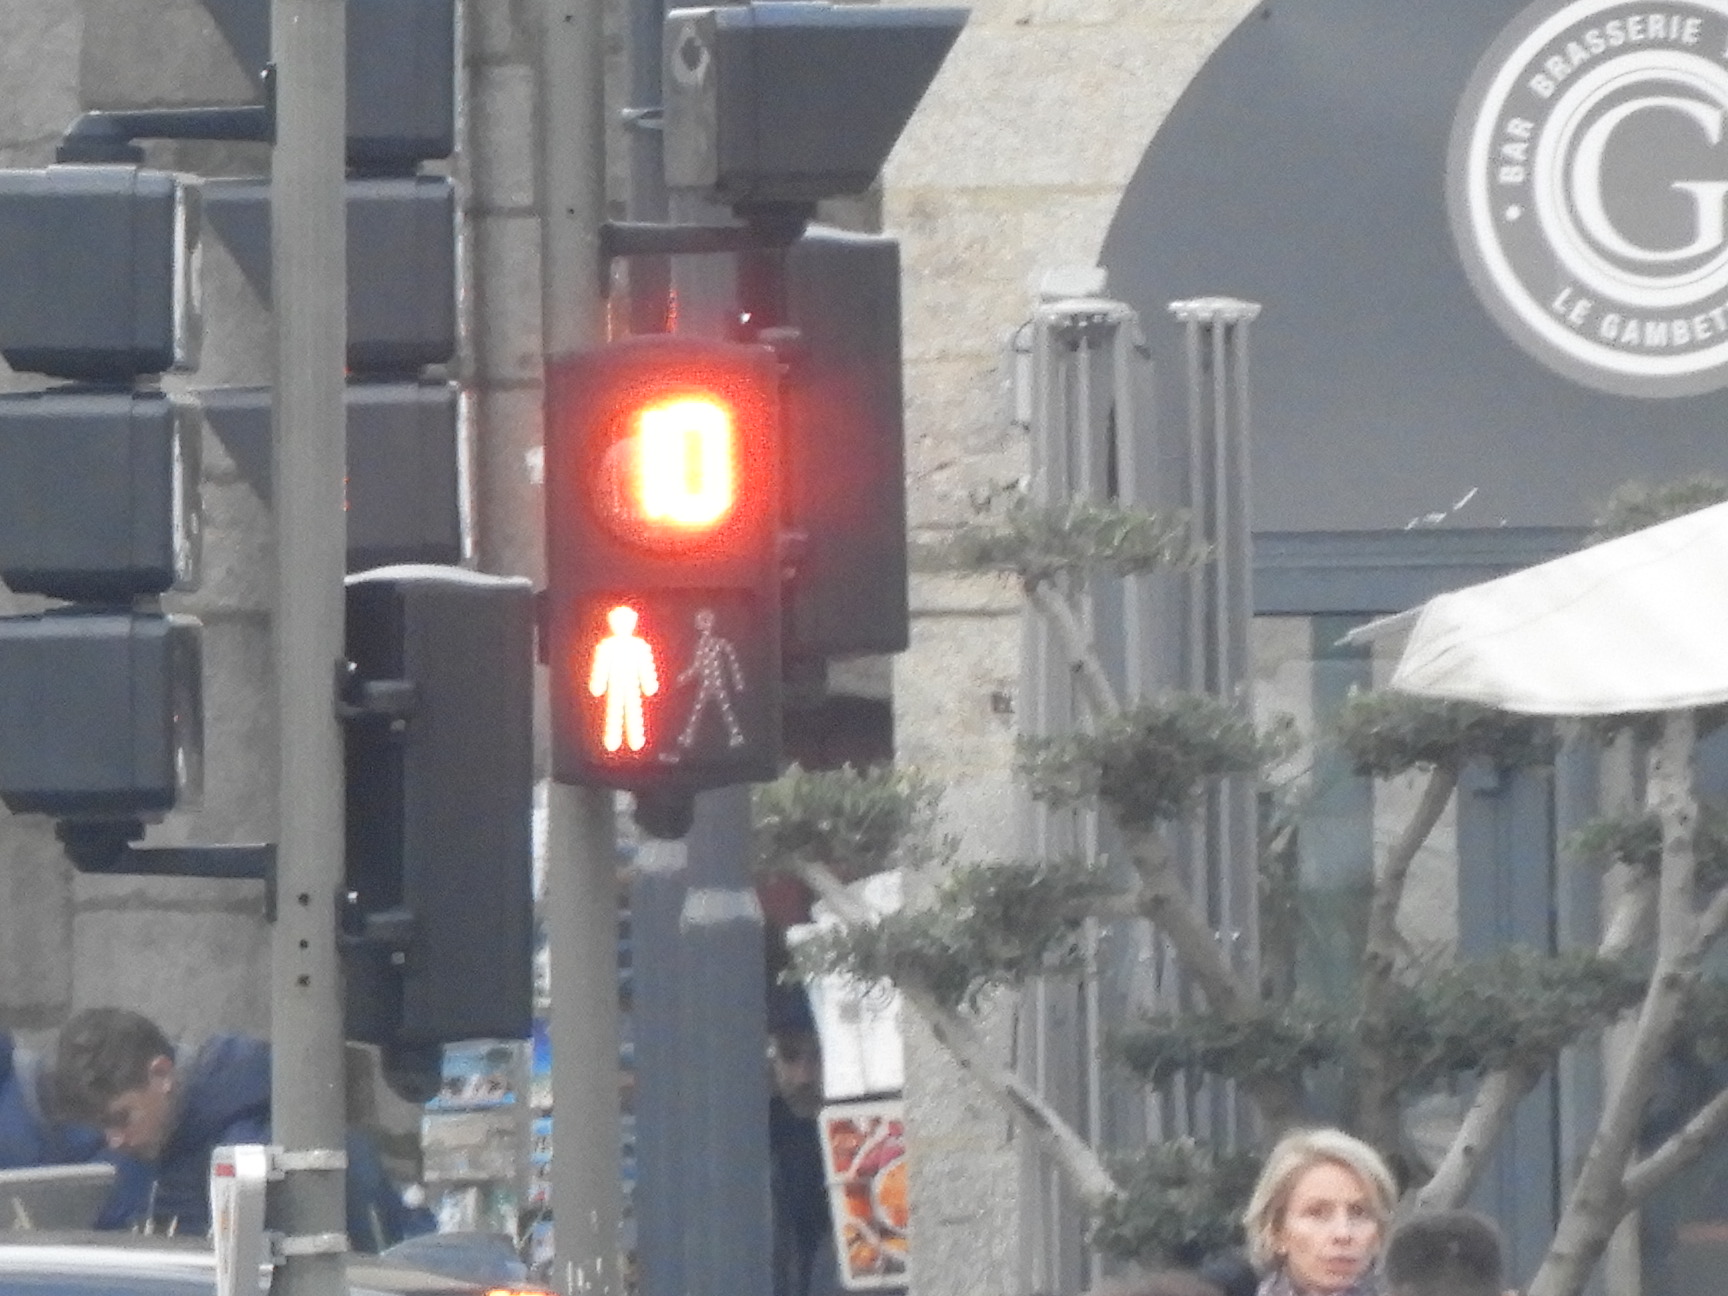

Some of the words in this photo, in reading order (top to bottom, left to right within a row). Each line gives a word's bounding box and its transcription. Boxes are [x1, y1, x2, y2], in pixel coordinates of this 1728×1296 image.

[1499, 117, 1535, 183] BAR
[1529, 13, 1702, 99] BRASSERIE
[1572, 96, 1728, 261] G
[1552, 286, 1592, 325] LE
